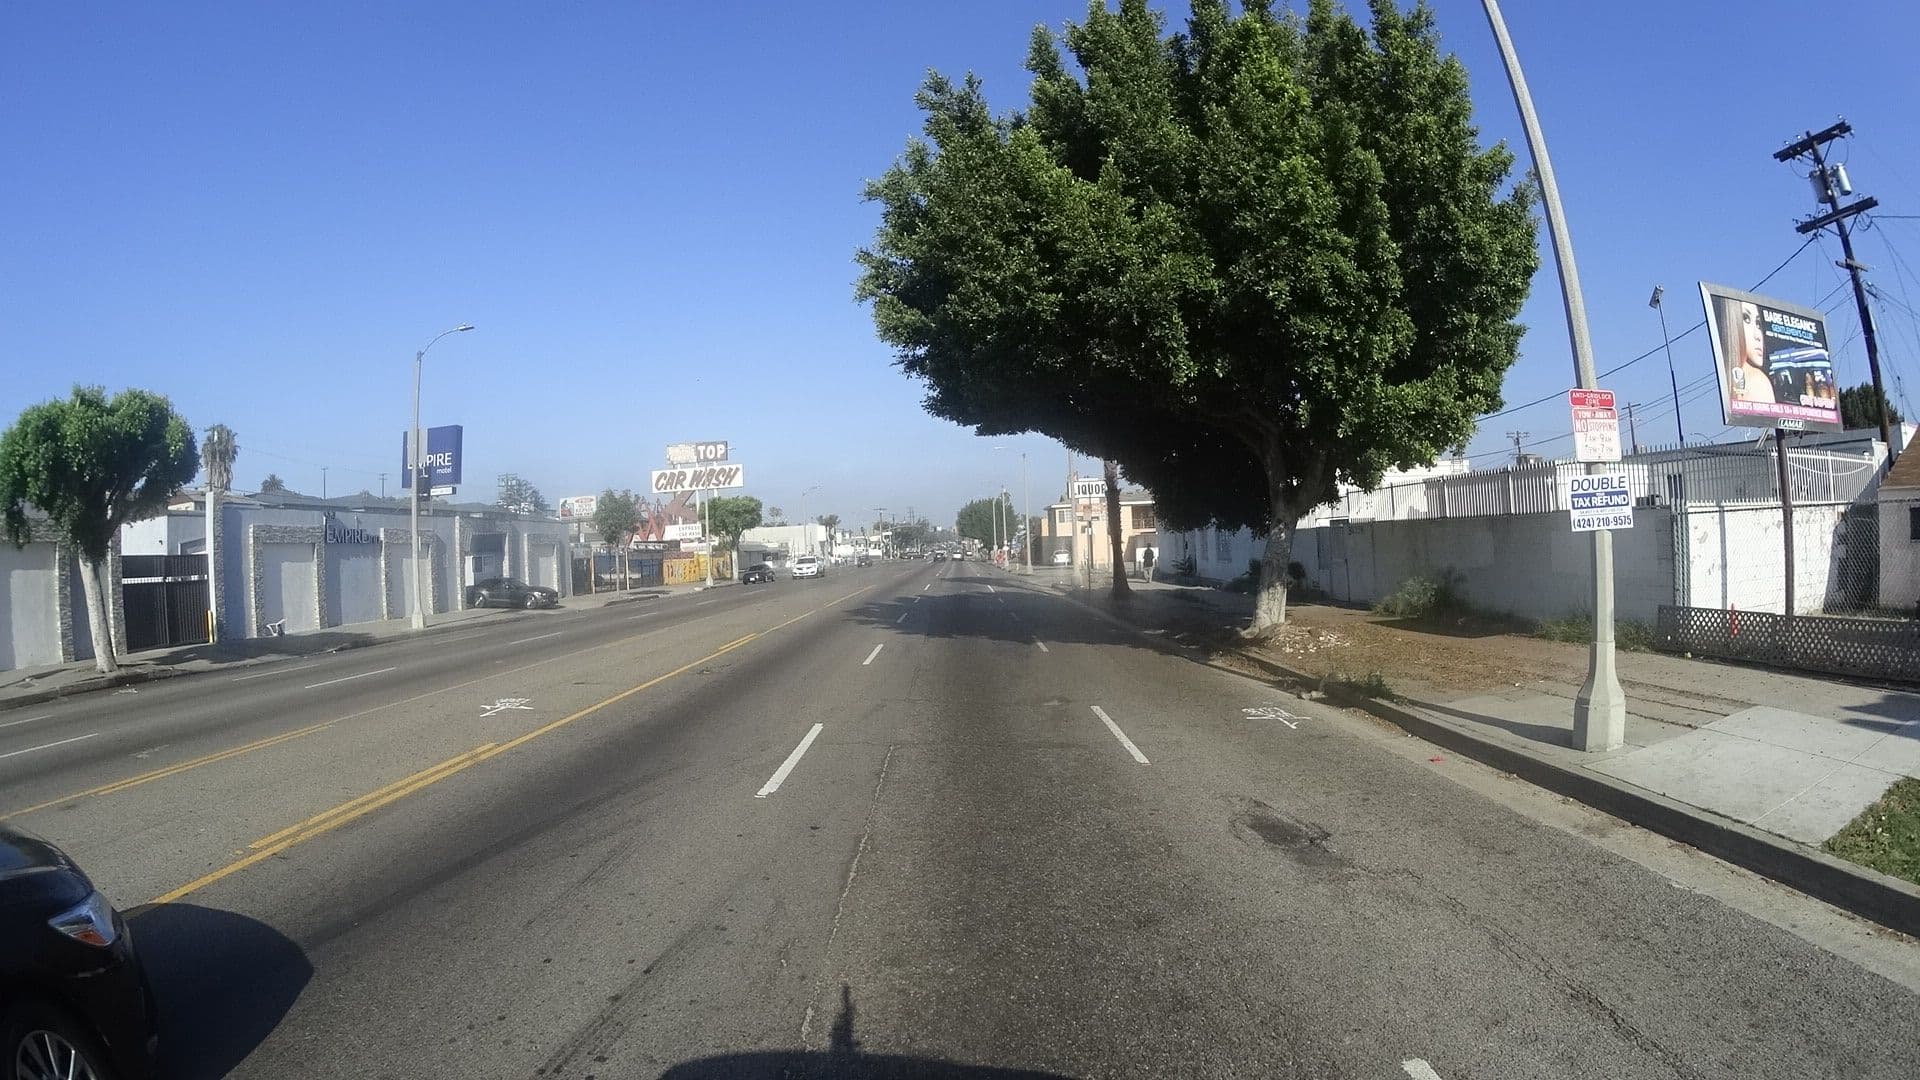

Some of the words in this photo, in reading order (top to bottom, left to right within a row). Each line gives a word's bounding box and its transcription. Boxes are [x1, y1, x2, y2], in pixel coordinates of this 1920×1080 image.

[1763, 310, 1784, 325] BARE
[1783, 314, 1817, 333] ELEGANCE
[1576, 420, 1587, 431] NO
[1780, 420, 1803, 428] LAMAR
[697, 444, 725, 460] TOP
[436, 466, 452, 474] motel
[655, 471, 687, 491] CAR
[689, 467, 740, 488] WASH
[1571, 476, 1626, 492] DOUBLE
[1074, 483, 1106, 495] IQUOR
[1573, 497, 1591, 508] TAX
[1592, 494, 1628, 507] REFUND
[1573, 517, 1595, 529] (424)
